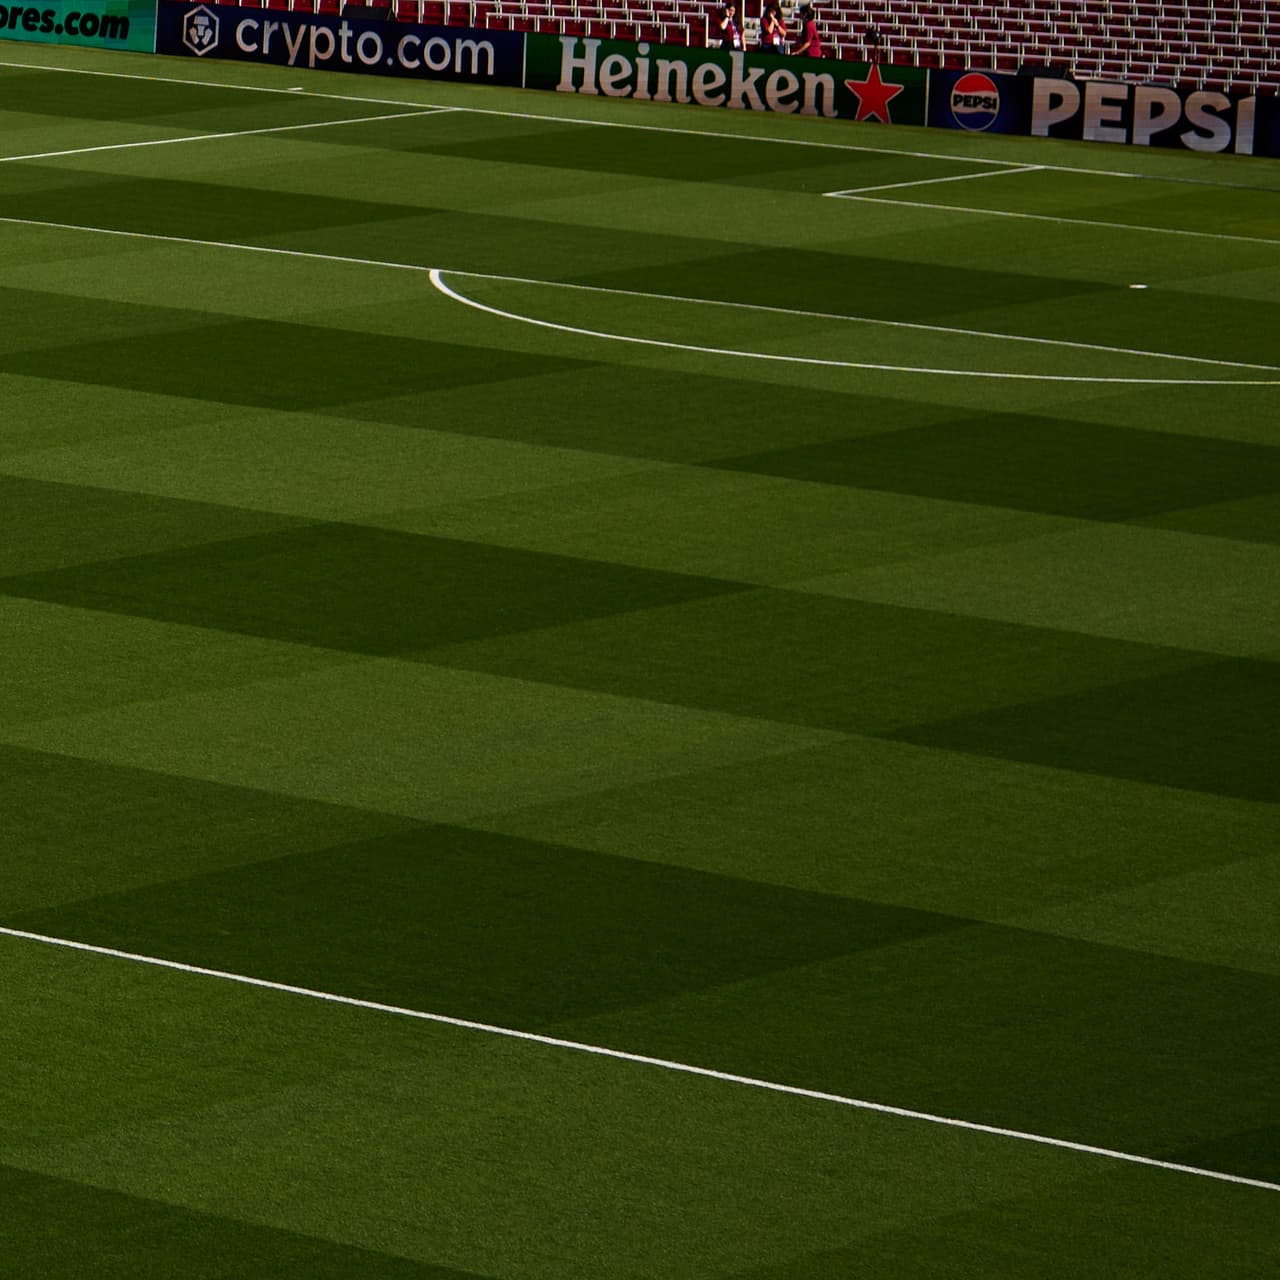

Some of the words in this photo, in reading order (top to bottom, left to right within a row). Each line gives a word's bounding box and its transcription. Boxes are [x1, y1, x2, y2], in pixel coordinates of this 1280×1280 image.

[235, 18, 495, 76] crypto.com
[556, 36, 839, 118] Heineken
[952, 93, 997, 110] PEPSI
[1031, 77, 1256, 155] PEPSI
